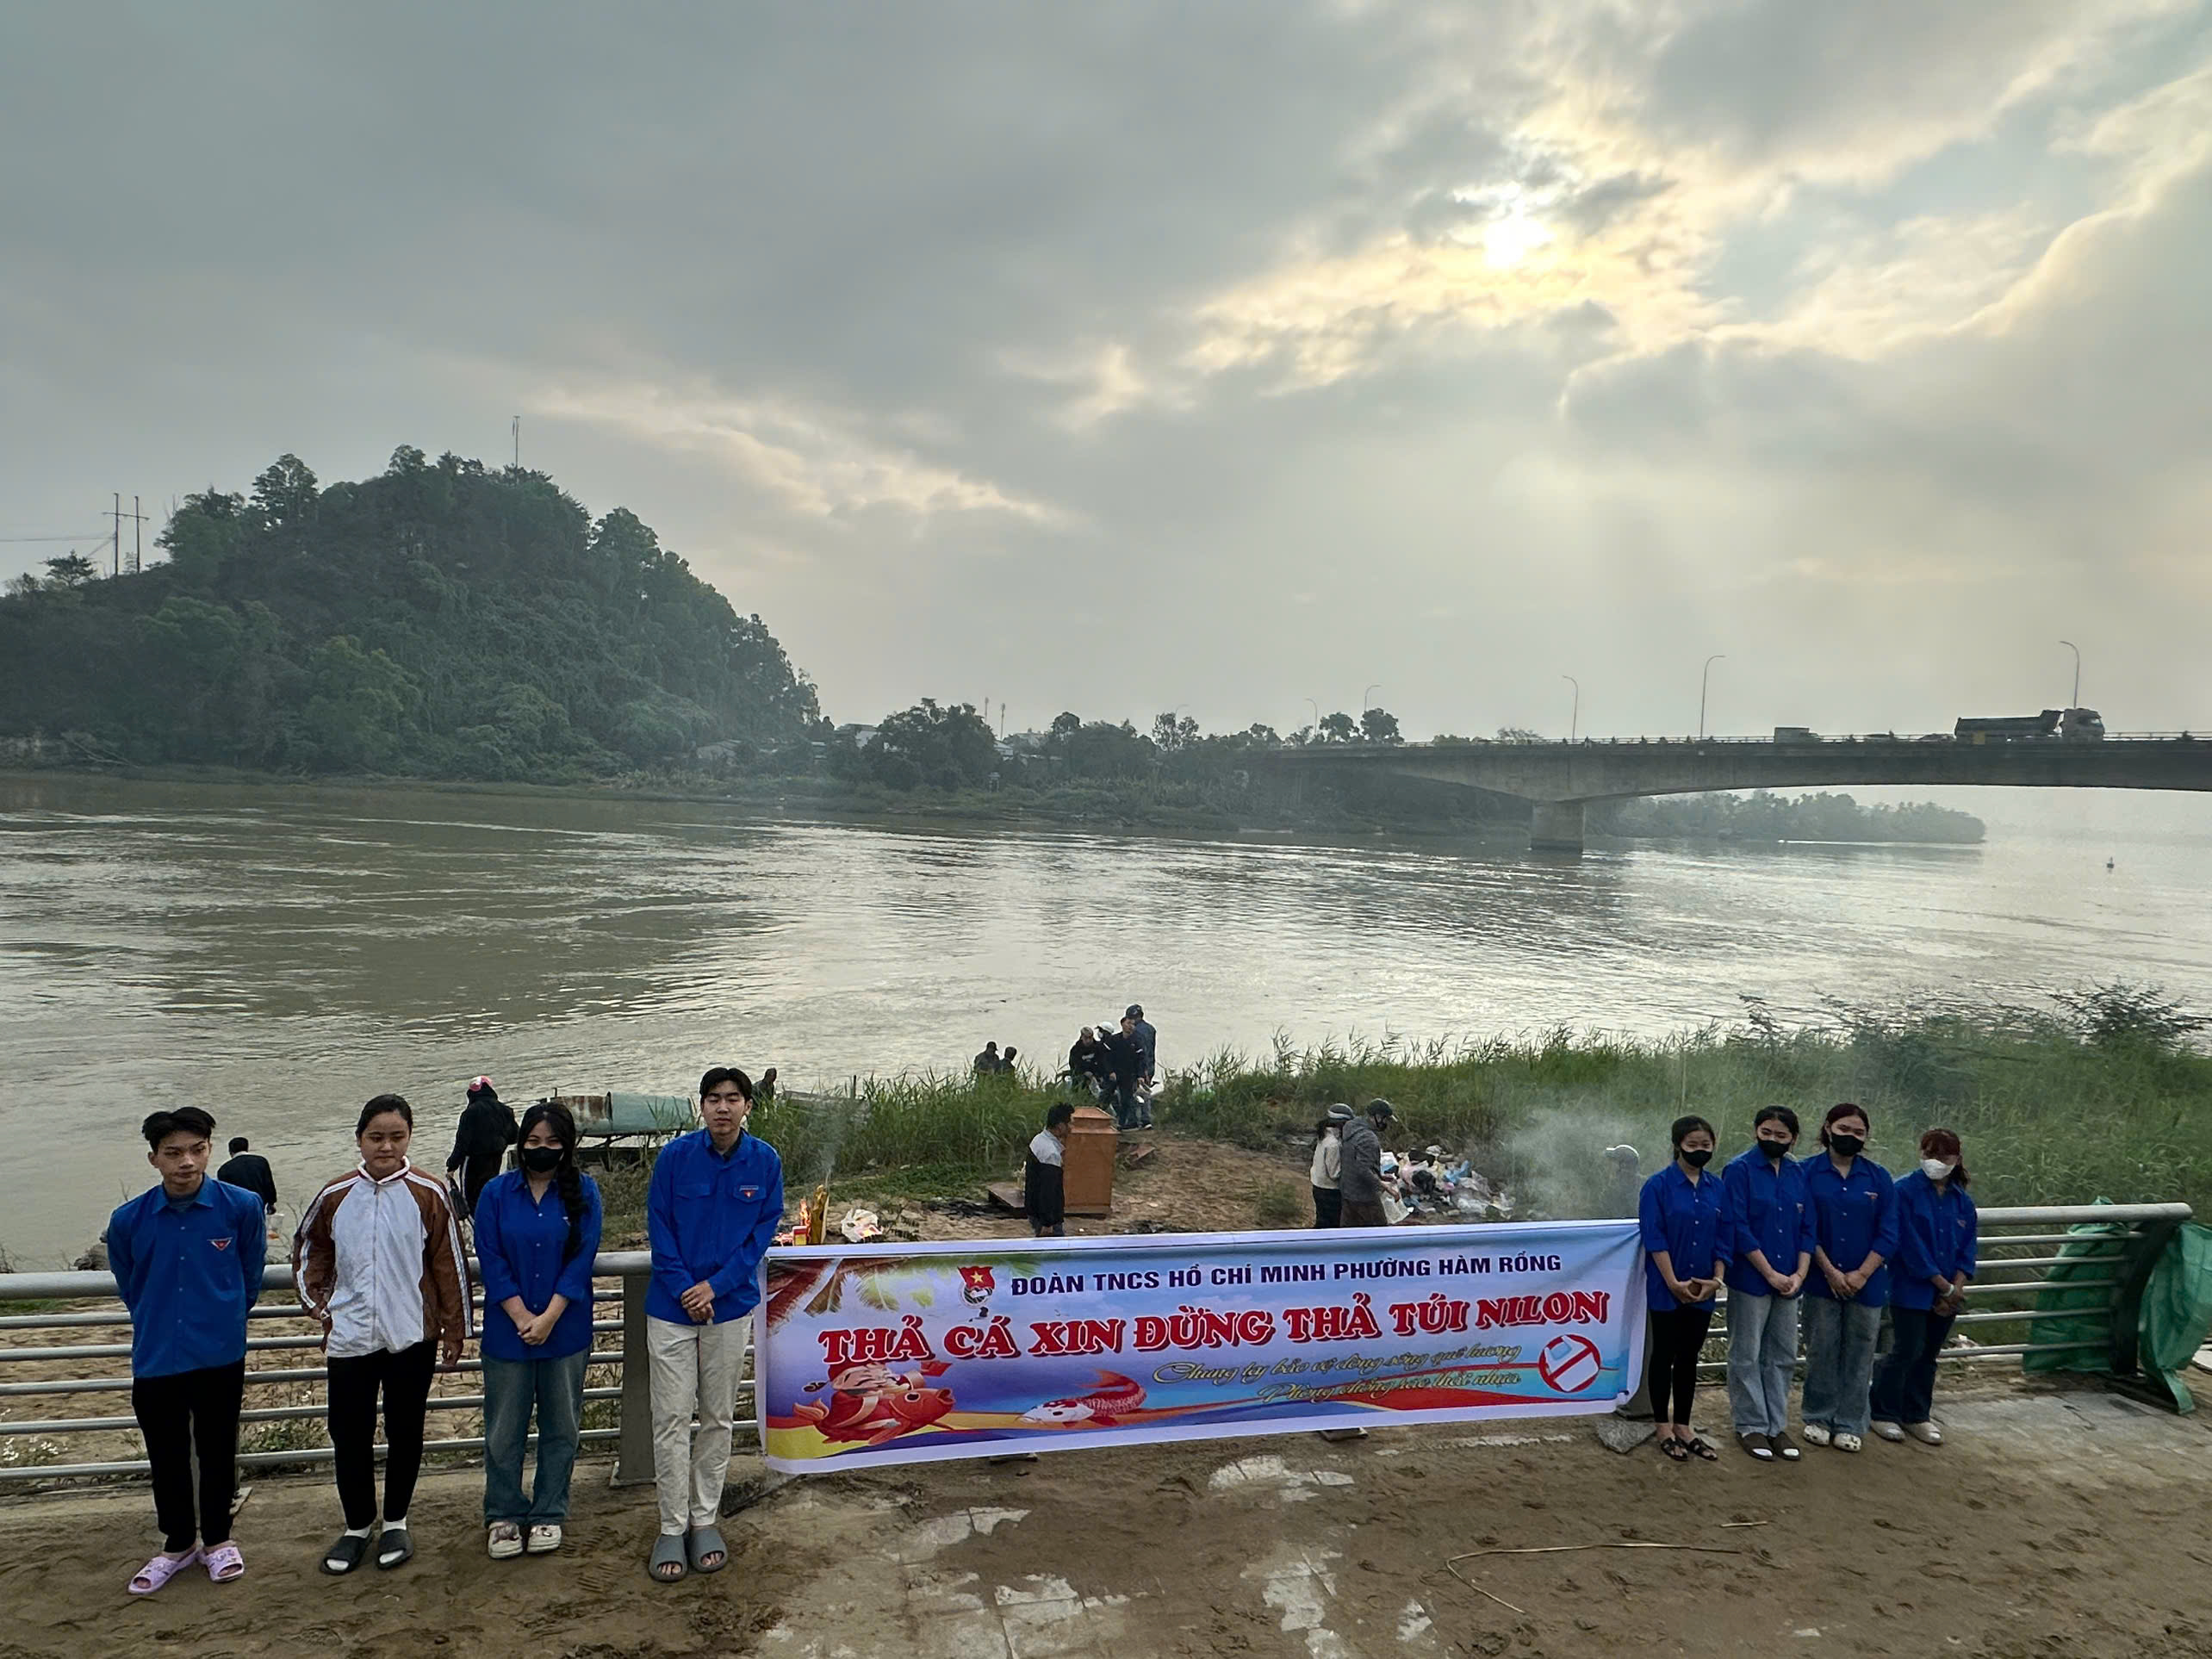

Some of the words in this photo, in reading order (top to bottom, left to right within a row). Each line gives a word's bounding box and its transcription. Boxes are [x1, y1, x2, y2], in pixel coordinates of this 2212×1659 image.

[1011, 1272, 1084, 1296] ĐOÀN
[1093, 1271, 1159, 1291] TNCS
[1168, 1264, 1202, 1288] HỒ
[1210, 1264, 1252, 1284] CHÍ
[1260, 1264, 1326, 1283] MINH
[1333, 1257, 1431, 1279] PHƯỜNG
[1438, 1255, 1491, 1275] HÀM
[818, 1314, 936, 1364] THẢ
[943, 1315, 1022, 1359] CÁ
[1027, 1318, 1126, 1358] XIN
[1133, 1304, 1276, 1352] ĐỪNG
[1282, 1291, 1382, 1344] THẢ
[1389, 1292, 1470, 1337] TÚI
[1475, 1290, 1611, 1331] NILON
[1153, 1361, 1240, 1386] Chung
